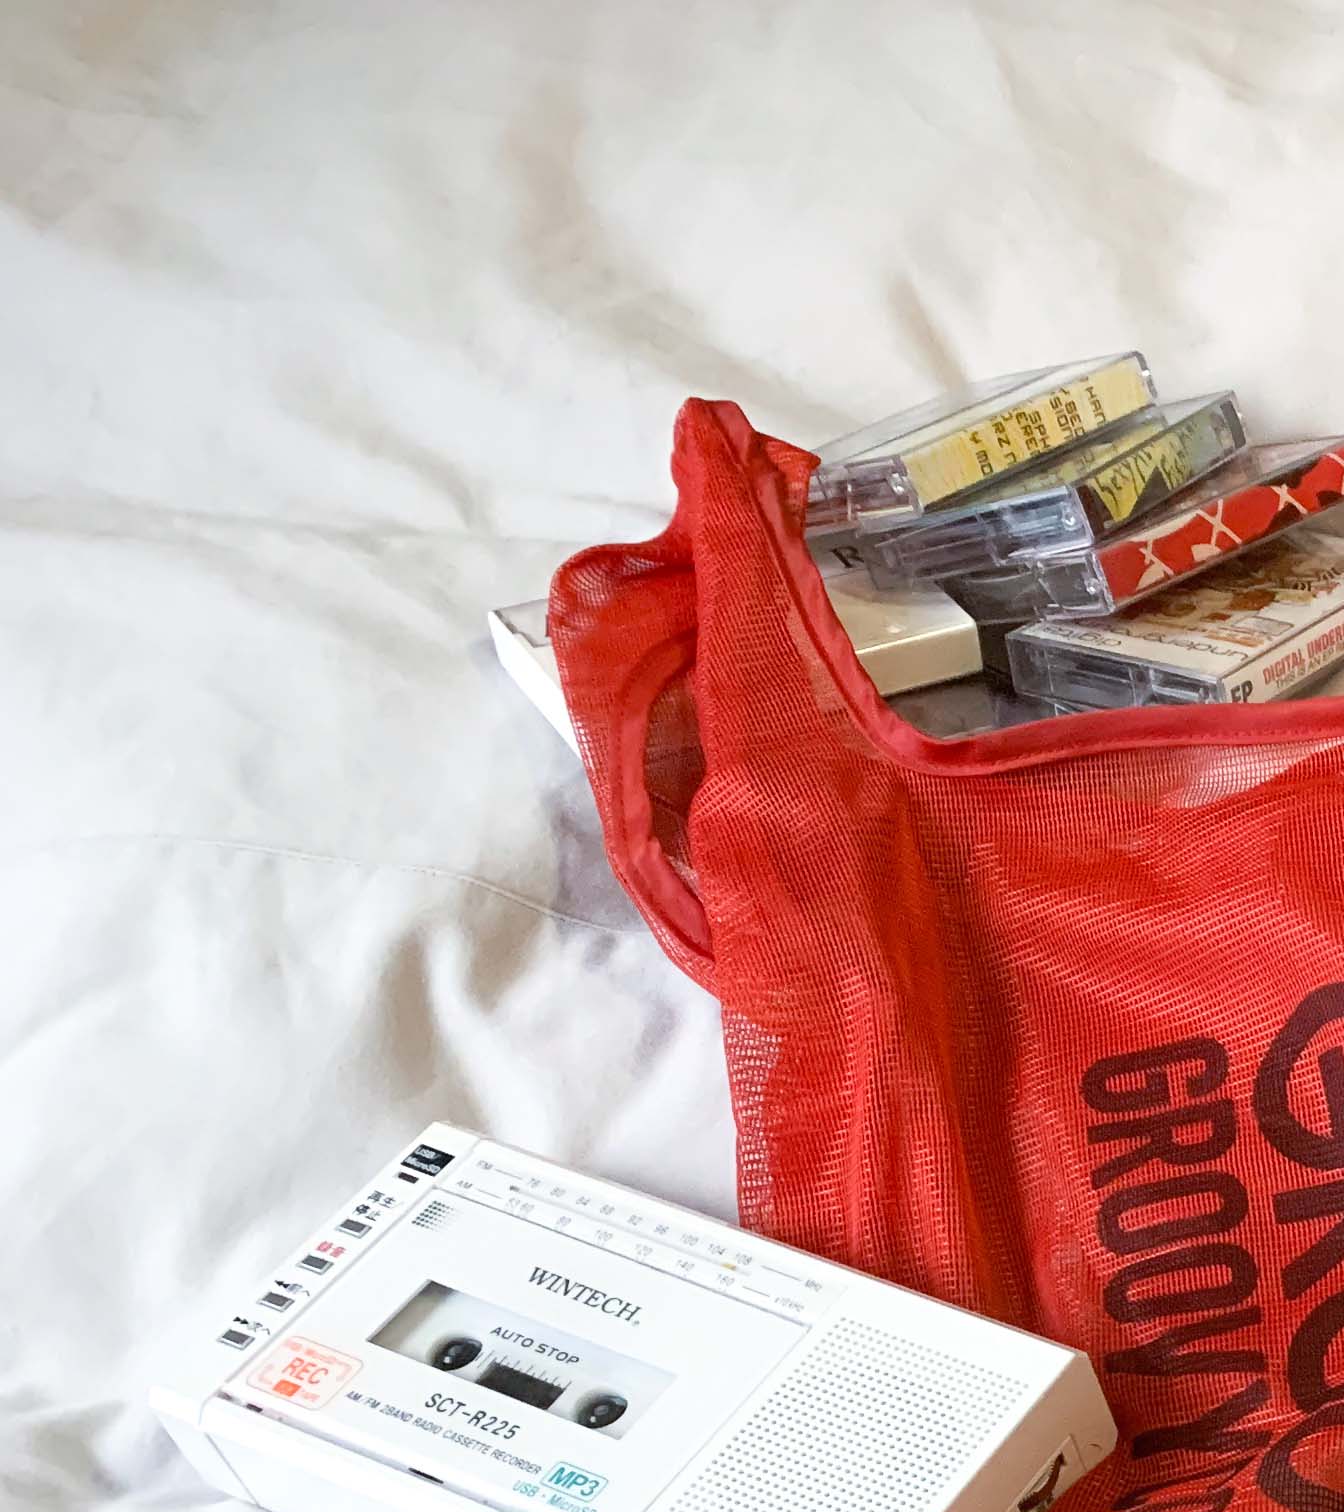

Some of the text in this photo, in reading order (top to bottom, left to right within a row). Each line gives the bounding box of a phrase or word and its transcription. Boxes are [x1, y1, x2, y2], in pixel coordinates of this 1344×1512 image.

[1262, 647, 1305, 686] DIGITAL
[528, 1266, 641, 1322] WINTECH
[490, 1326, 580, 1365] AUTO STOP
[282, 1357, 329, 1385] REC
[424, 1393, 521, 1441] SCT-R225
[413, 1416, 442, 1435] RADIO
[442, 1429, 491, 1456] CASSETTE
[490, 1448, 543, 1476] RECORDER
[512, 1479, 539, 1499] USB
[547, 1466, 601, 1498] MP3
